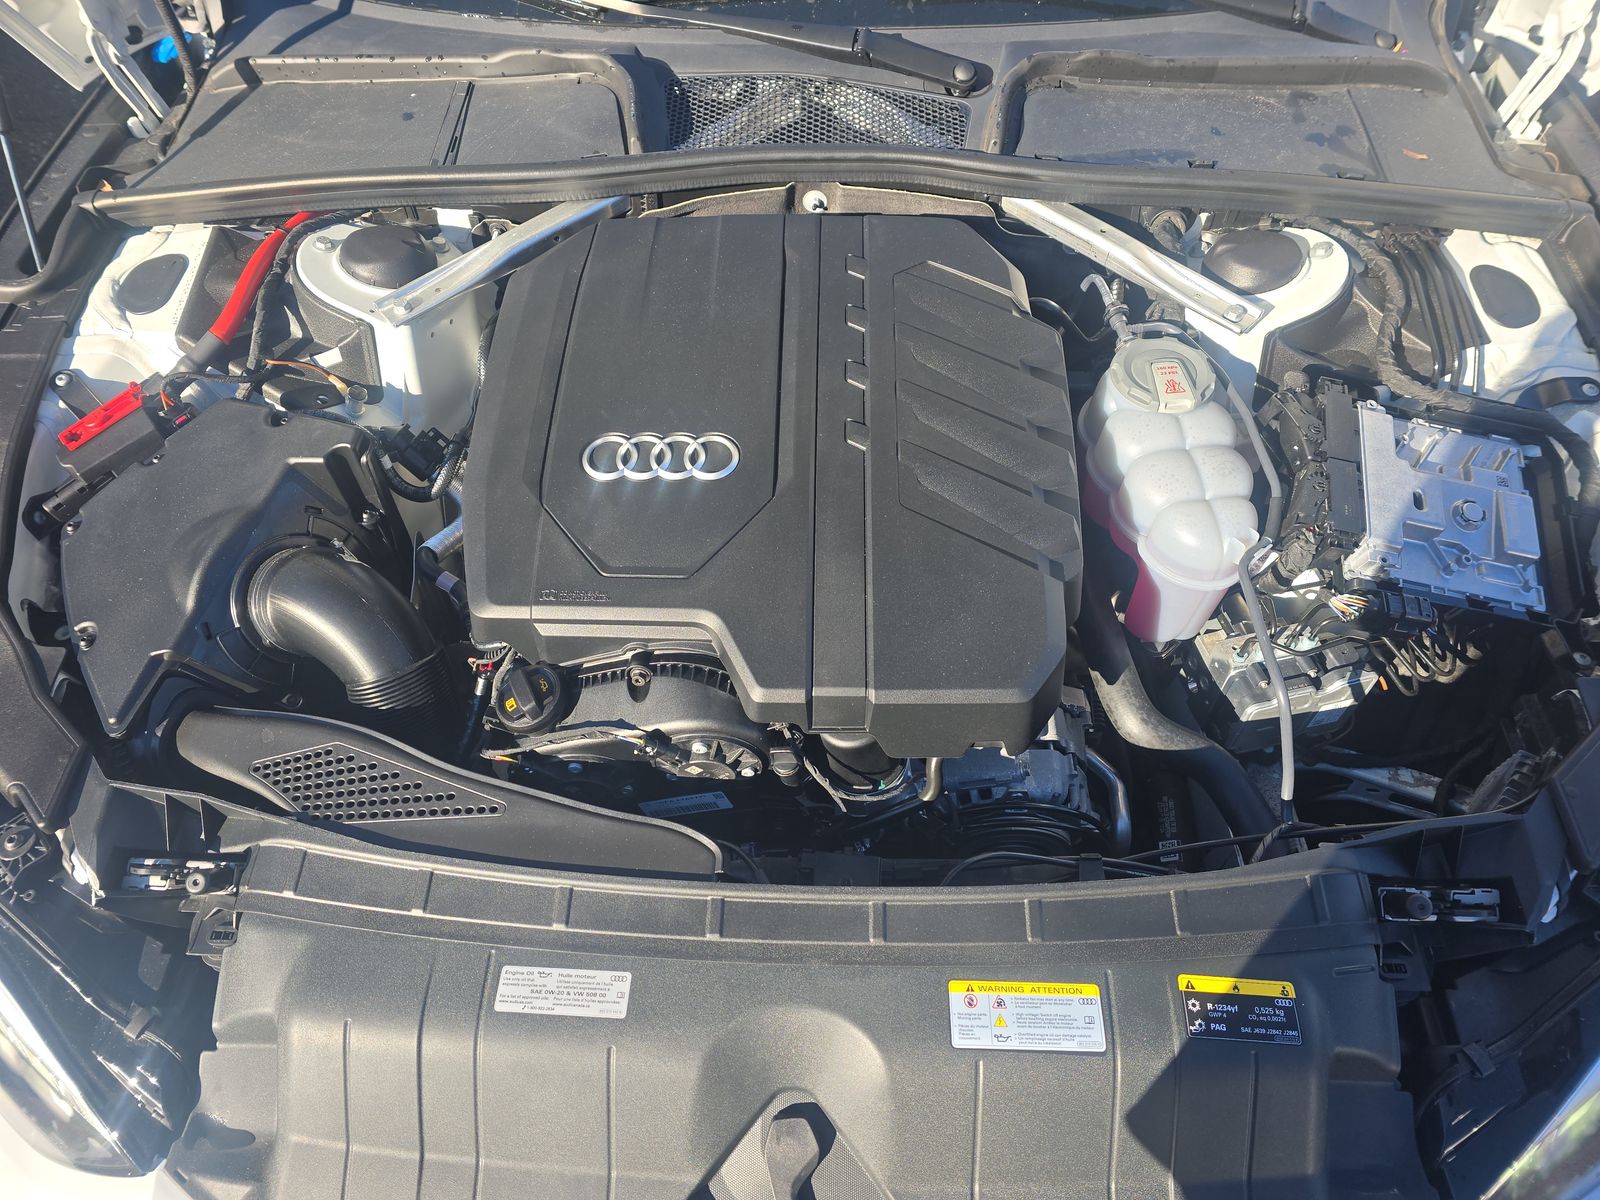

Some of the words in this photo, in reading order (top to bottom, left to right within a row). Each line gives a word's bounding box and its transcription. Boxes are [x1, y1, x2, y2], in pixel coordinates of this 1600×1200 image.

[977, 985, 1025, 993] WARNING
[1030, 986, 1083, 995] ATTENTION
[1207, 1003, 1239, 1013] R-1234yf
[1276, 1008, 1285, 1016] kg
[1210, 1023, 1227, 1031] PAG
